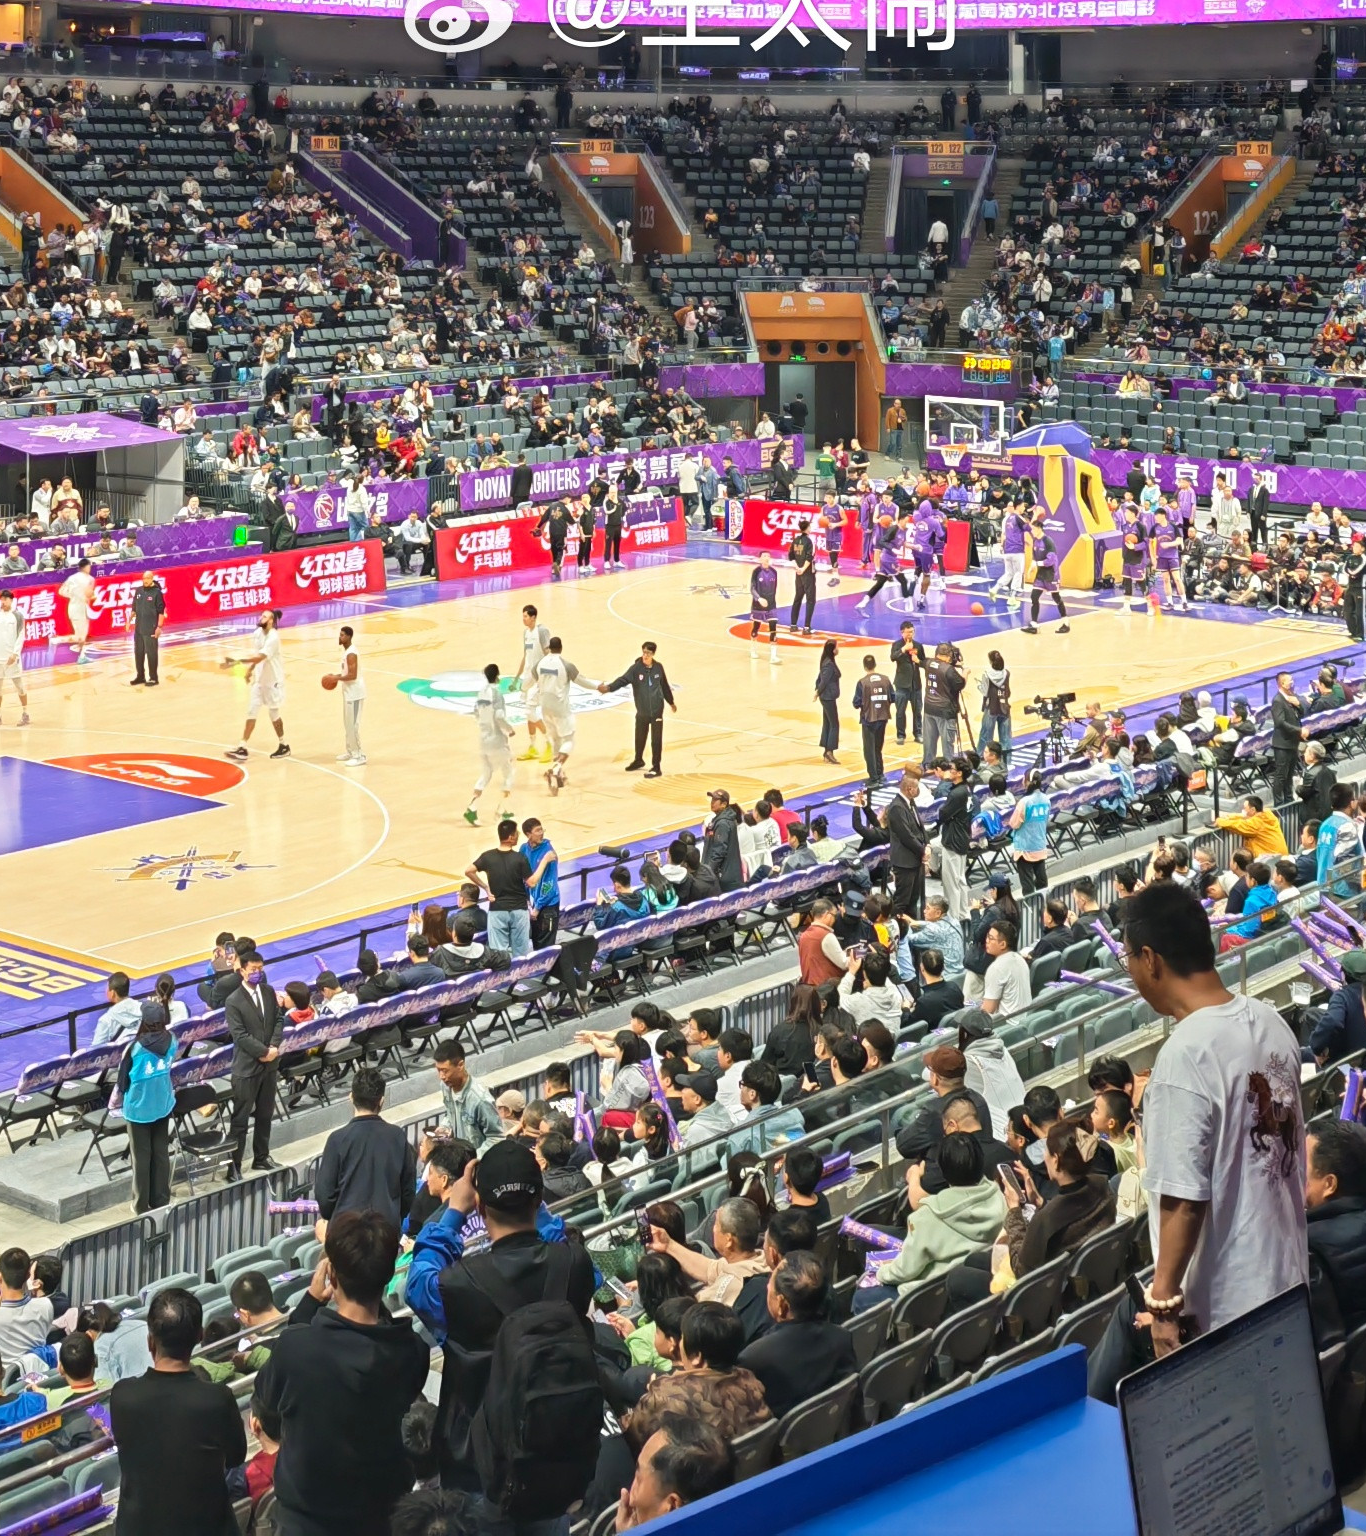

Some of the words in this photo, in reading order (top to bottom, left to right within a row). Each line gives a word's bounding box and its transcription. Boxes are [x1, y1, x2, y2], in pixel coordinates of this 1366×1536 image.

[314, 138, 323, 149] 101
[327, 138, 338, 149] 124
[582, 141, 594, 151] 124
[600, 141, 611, 151] 123
[930, 143, 943, 154] 123
[948, 143, 962, 154] 122
[1240, 144, 1253, 155] 122
[1258, 144, 1269, 155] 121
[529, 467, 580, 494] IGHTERS
[459, 526, 511, 552] 红双喜
[300, 545, 366, 577] 红双喜
[473, 550, 512, 571] 乒乓器材
[199, 559, 271, 594] 红双喜
[318, 574, 367, 596] 羽球器材
[219, 587, 272, 611] 足篮排球
